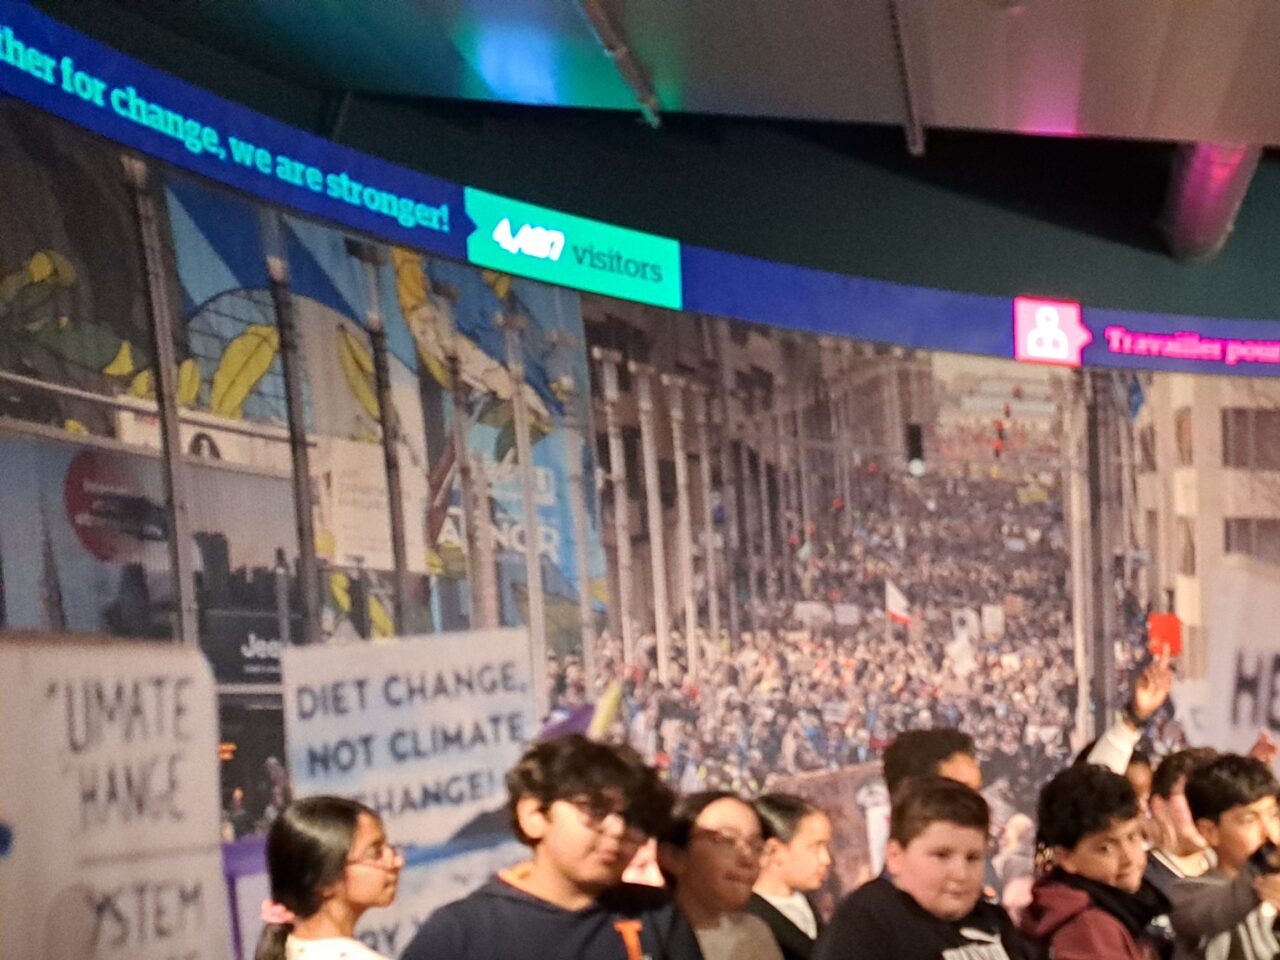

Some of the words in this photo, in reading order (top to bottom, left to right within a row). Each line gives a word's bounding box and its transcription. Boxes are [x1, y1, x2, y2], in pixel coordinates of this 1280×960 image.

[60, 56, 107, 108] for
[111, 86, 227, 160] change,
[229, 136, 272, 175] we
[276, 155, 323, 193] are
[326, 172, 450, 234] stronger!
[572, 244, 664, 283] visitors
[241, 633, 282, 659] Jee
[296, 679, 369, 721] DIET
[383, 660, 527, 707] CHANGE,
[307, 735, 375, 777] NOT
[388, 711, 526, 763] CLIMATE
[356, 770, 495, 815] HANGE!
